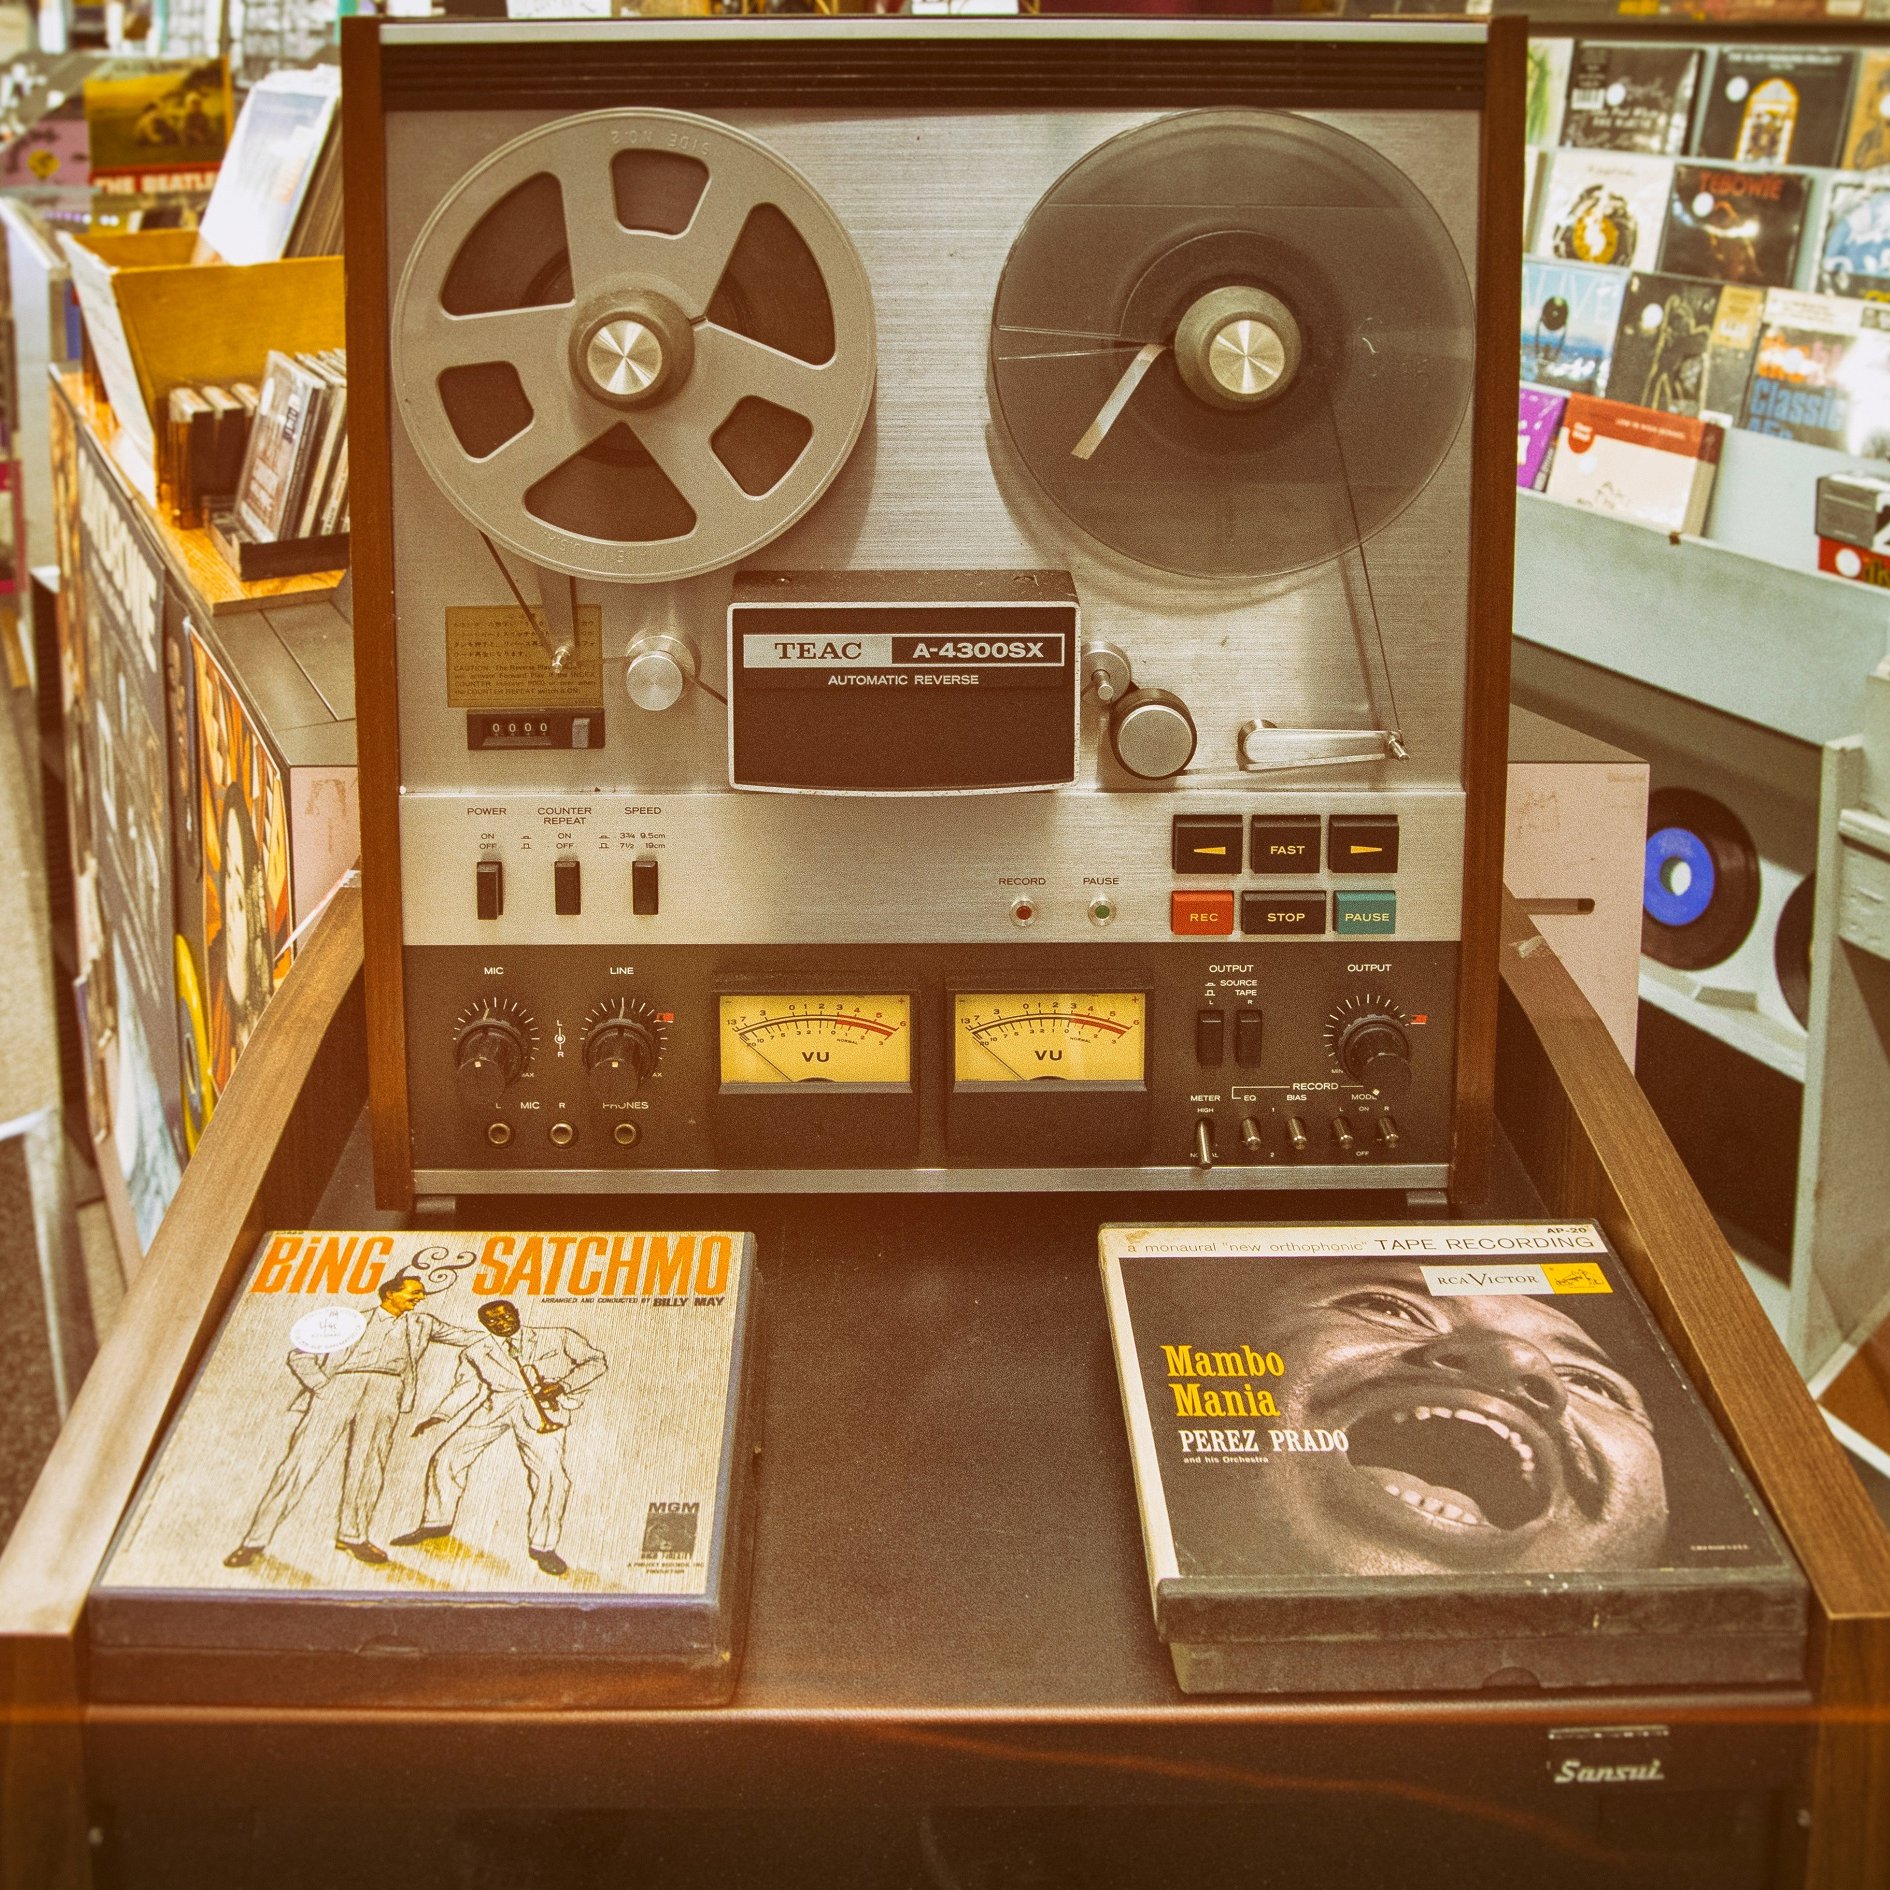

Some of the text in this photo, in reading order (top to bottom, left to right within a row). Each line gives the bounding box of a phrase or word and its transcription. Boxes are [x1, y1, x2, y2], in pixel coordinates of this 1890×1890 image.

[774, 642, 862, 660] TEAC
[912, 642, 1044, 658] A-4300SX
[828, 674, 980, 686] AUTOMATIC REVERSE
[467, 807, 507, 816] POWER
[537, 807, 592, 815] COUNTER
[624, 807, 662, 815] SPEED
[1270, 845, 1305, 856] FAST
[998, 877, 1046, 886] RECORD
[1083, 877, 1119, 885] PAUSE
[1189, 913, 1219, 922] REC
[1267, 913, 1305, 922] STOP
[1345, 913, 1390, 922] PAUSE
[484, 967, 504, 975] MIC
[610, 967, 634, 975] LINE
[1209, 964, 1254, 973] OUTPUT
[1347, 964, 1392, 972] OUTPUT
[802, 1051, 830, 1062] VU
[1035, 1050, 1063, 1060] VU
[1127, 1243, 1136, 1252] a
[1145, 1242, 1216, 1252] monaural
[1374, 1238, 1438, 1251] TAPE
[1445, 1236, 1594, 1250] RECORDING
[472, 1236, 732, 1296] SATCHMO
[1437, 1274, 1469, 1286] RCA
[653, 1297, 689, 1306] BILLY
[694, 1297, 725, 1306] MAY
[1160, 1344, 1285, 1377] Mambo
[1168, 1383, 1280, 1417] Mania
[1178, 1429, 1349, 1452] PEREZ PRADO
[649, 1502, 700, 1513] MGM
[1554, 1758, 1665, 1784] Sansui
